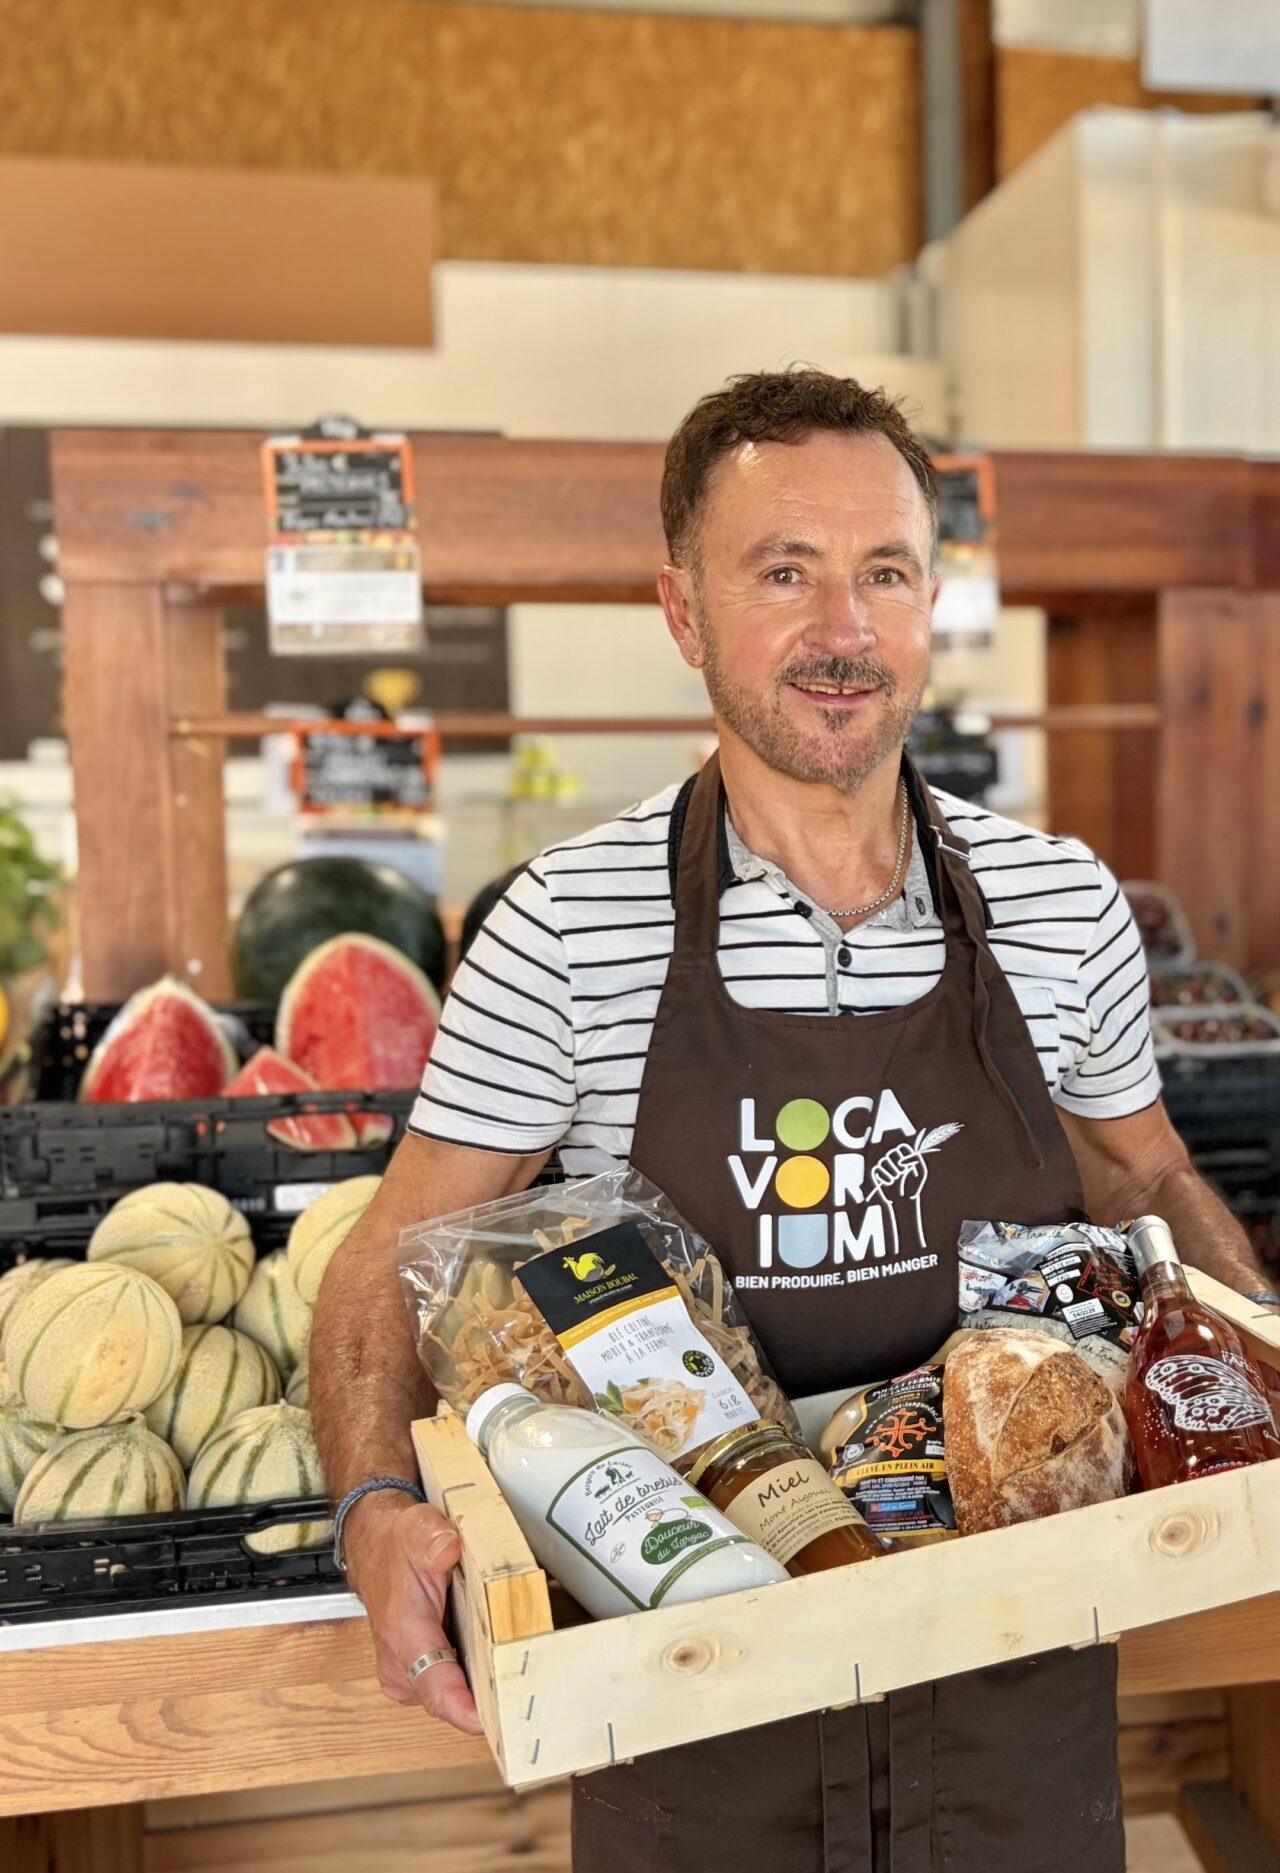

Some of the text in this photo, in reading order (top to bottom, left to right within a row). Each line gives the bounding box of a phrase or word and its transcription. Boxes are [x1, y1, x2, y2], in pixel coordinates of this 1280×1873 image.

[741, 1088, 917, 1151] LOCA
[728, 1153, 865, 1209] VOR
[759, 1204, 886, 1268] IUM
[735, 1254, 938, 1289] BIEN PRODUIRE, BIEN MANGER
[573, 1284, 607, 1304] MAISON
[895, 1461, 918, 1470] PLEIN
[757, 1470, 810, 1508] Miel
[585, 1509, 613, 1546] Lait
[614, 1493, 635, 1513] de
[759, 1505, 787, 1531] Mont
[644, 1519, 700, 1555] Douceur
[657, 1531, 709, 1561] du Larzac
